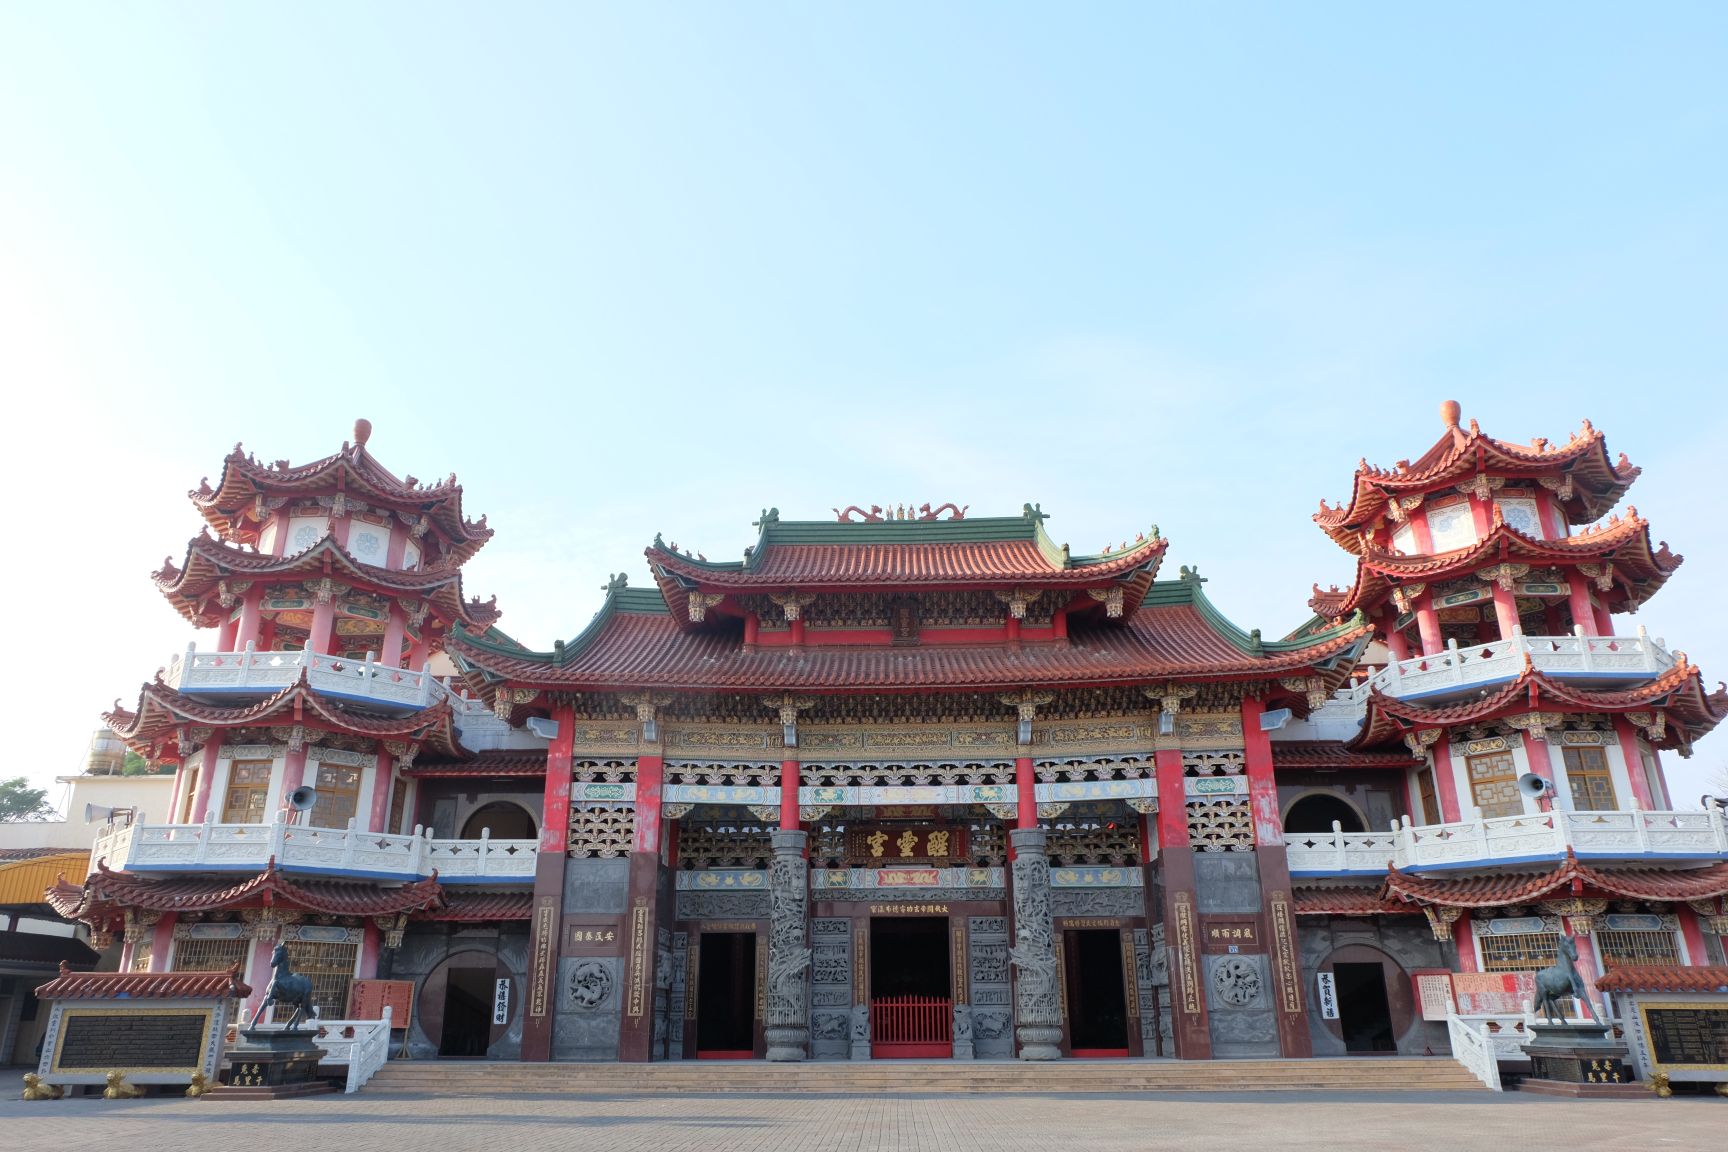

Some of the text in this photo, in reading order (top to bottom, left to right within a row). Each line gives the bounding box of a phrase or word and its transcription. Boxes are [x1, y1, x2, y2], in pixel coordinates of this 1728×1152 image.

[866, 830, 950, 858] 醒靈宮
[574, 930, 615, 942] 國泰民安
[1211, 928, 1254, 939] 風調雨順
[233, 1075, 263, 1086] 千里馬
[1587, 1072, 1621, 1084] 千里馬
